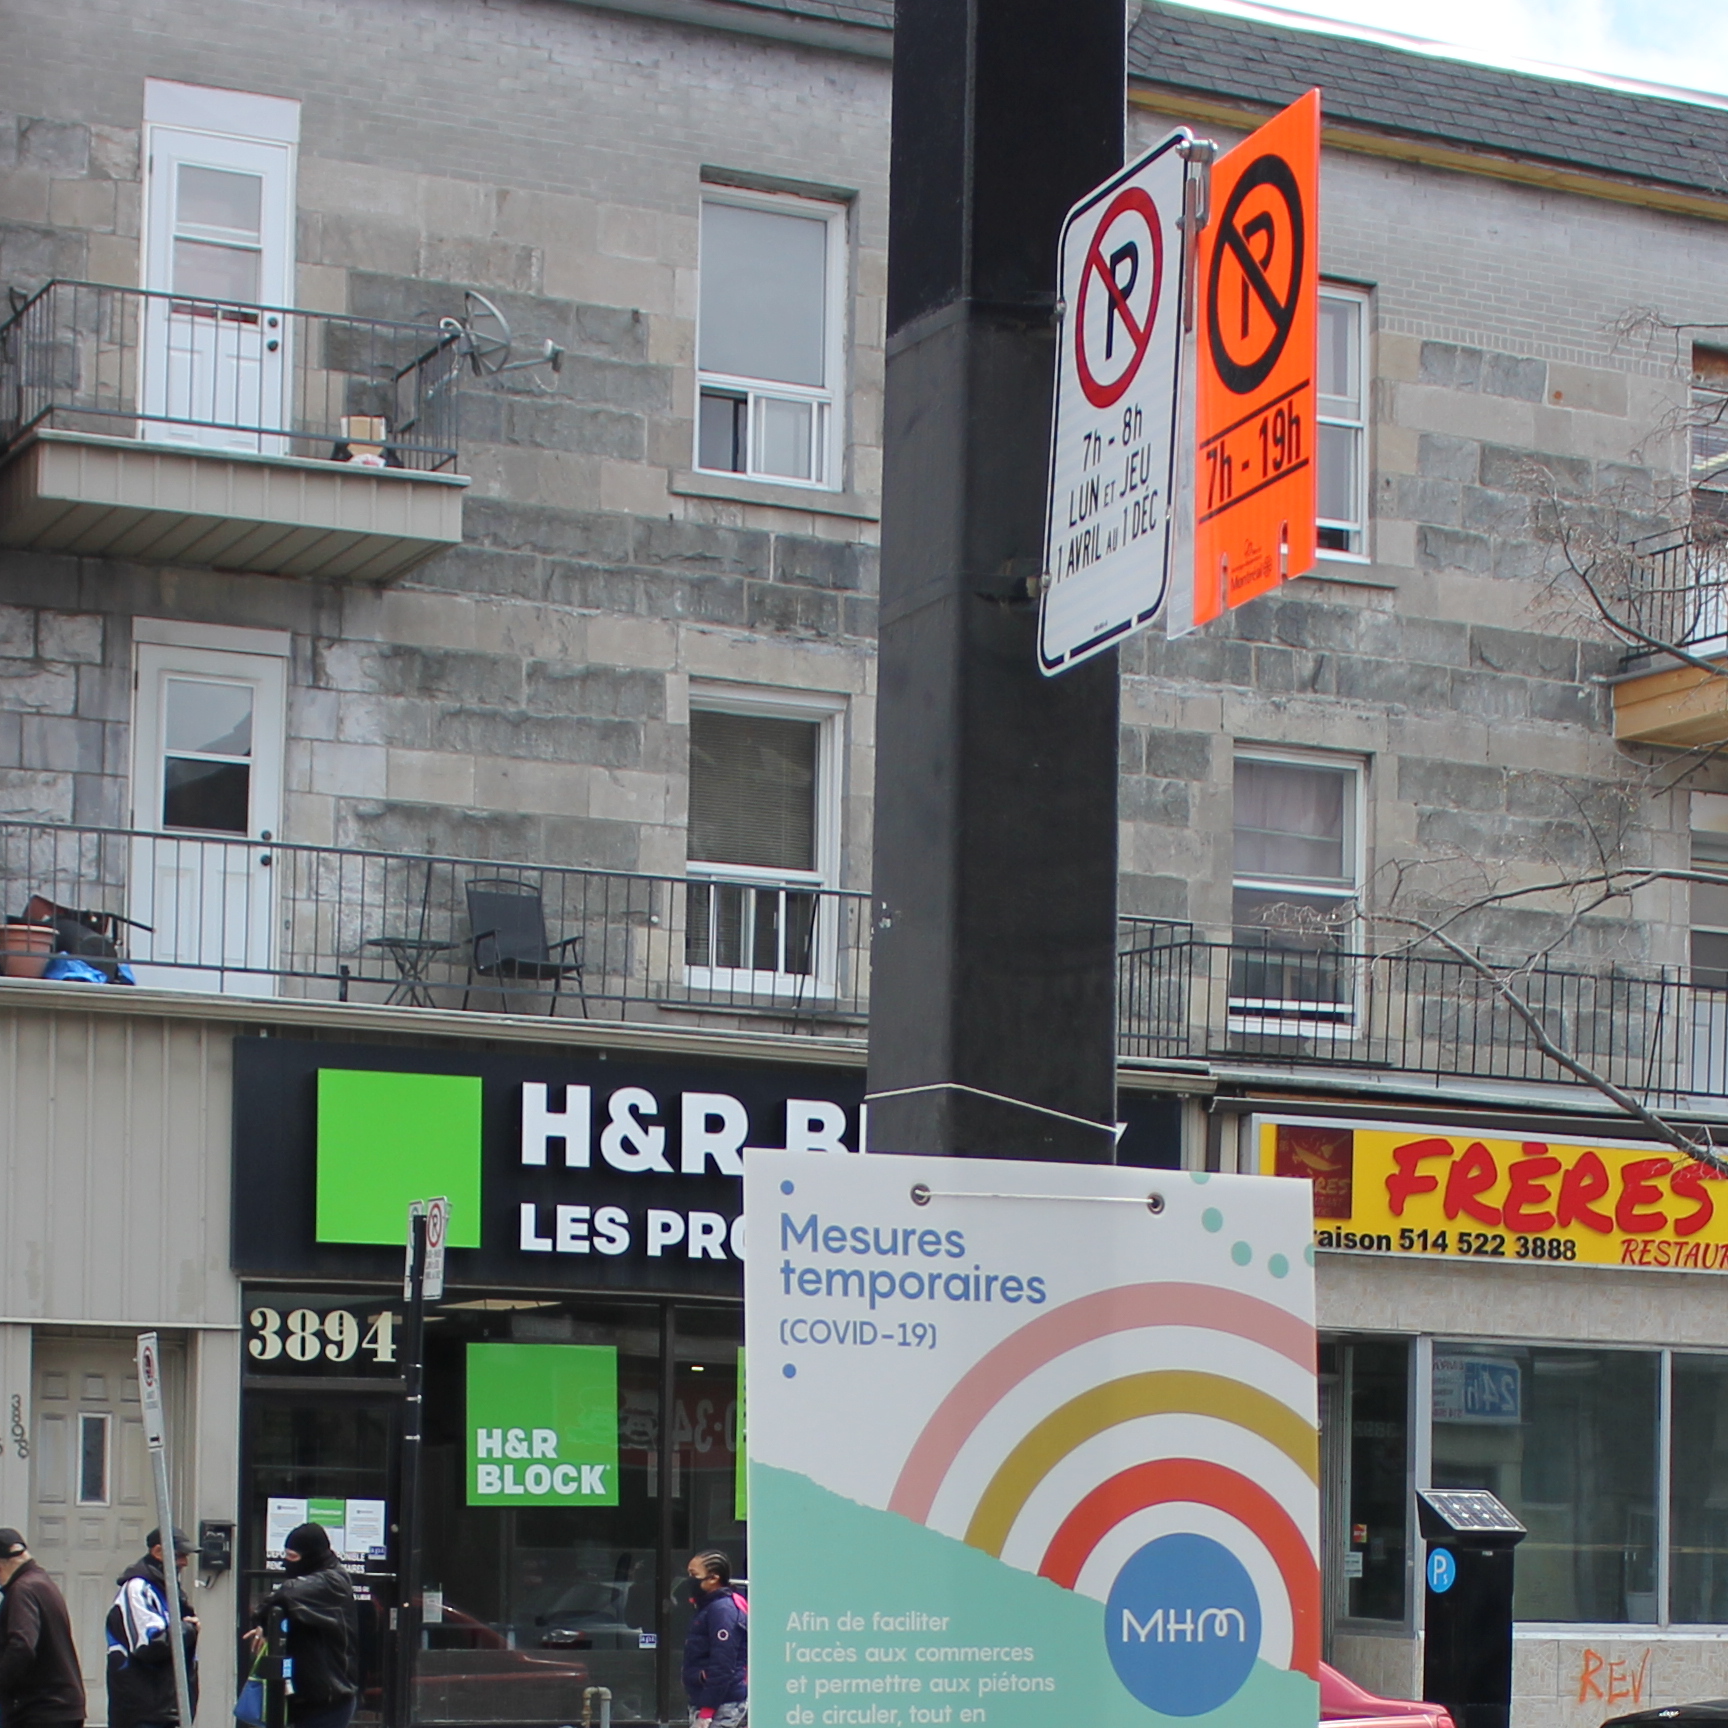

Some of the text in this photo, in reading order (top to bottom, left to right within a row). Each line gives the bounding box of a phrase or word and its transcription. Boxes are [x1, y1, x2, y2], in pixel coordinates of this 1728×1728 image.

[1083, 429, 1102, 472] 7h
[1122, 403, 1142, 446] 8h
[1206, 440, 1232, 509] 7h
[1260, 400, 1300, 479] 19h
[1069, 443, 1150, 528] LUN ET JEU
[1057, 487, 1157, 583] 1 AVRIL AU 1 DÉC
[522, 1081, 750, 1177] H&R
[520, 1202, 630, 1256] LES
[781, 1213, 965, 1258] Mesures
[1399, 1228, 1448, 1252] 514
[1457, 1232, 1505, 1256] 522
[1515, 1236, 1576, 1261] 3888
[780, 1260, 1046, 1310] temporaires
[248, 1307, 397, 1362] 3894
[780, 1319, 936, 1349] (COVID-19)
[476, 1427, 558, 1459] H&R
[476, 1464, 606, 1495] BLOCK
[787, 1611, 949, 1631] Afin de faciliter
[1123, 1608, 1244, 1642] MHM
[786, 1642, 1033, 1662] l'accès aux commerces
[786, 1671, 1055, 1699] et permettre aux piétons
[1579, 1649, 1651, 1703] REV
[787, 1703, 985, 1727] de circuler, tout en
